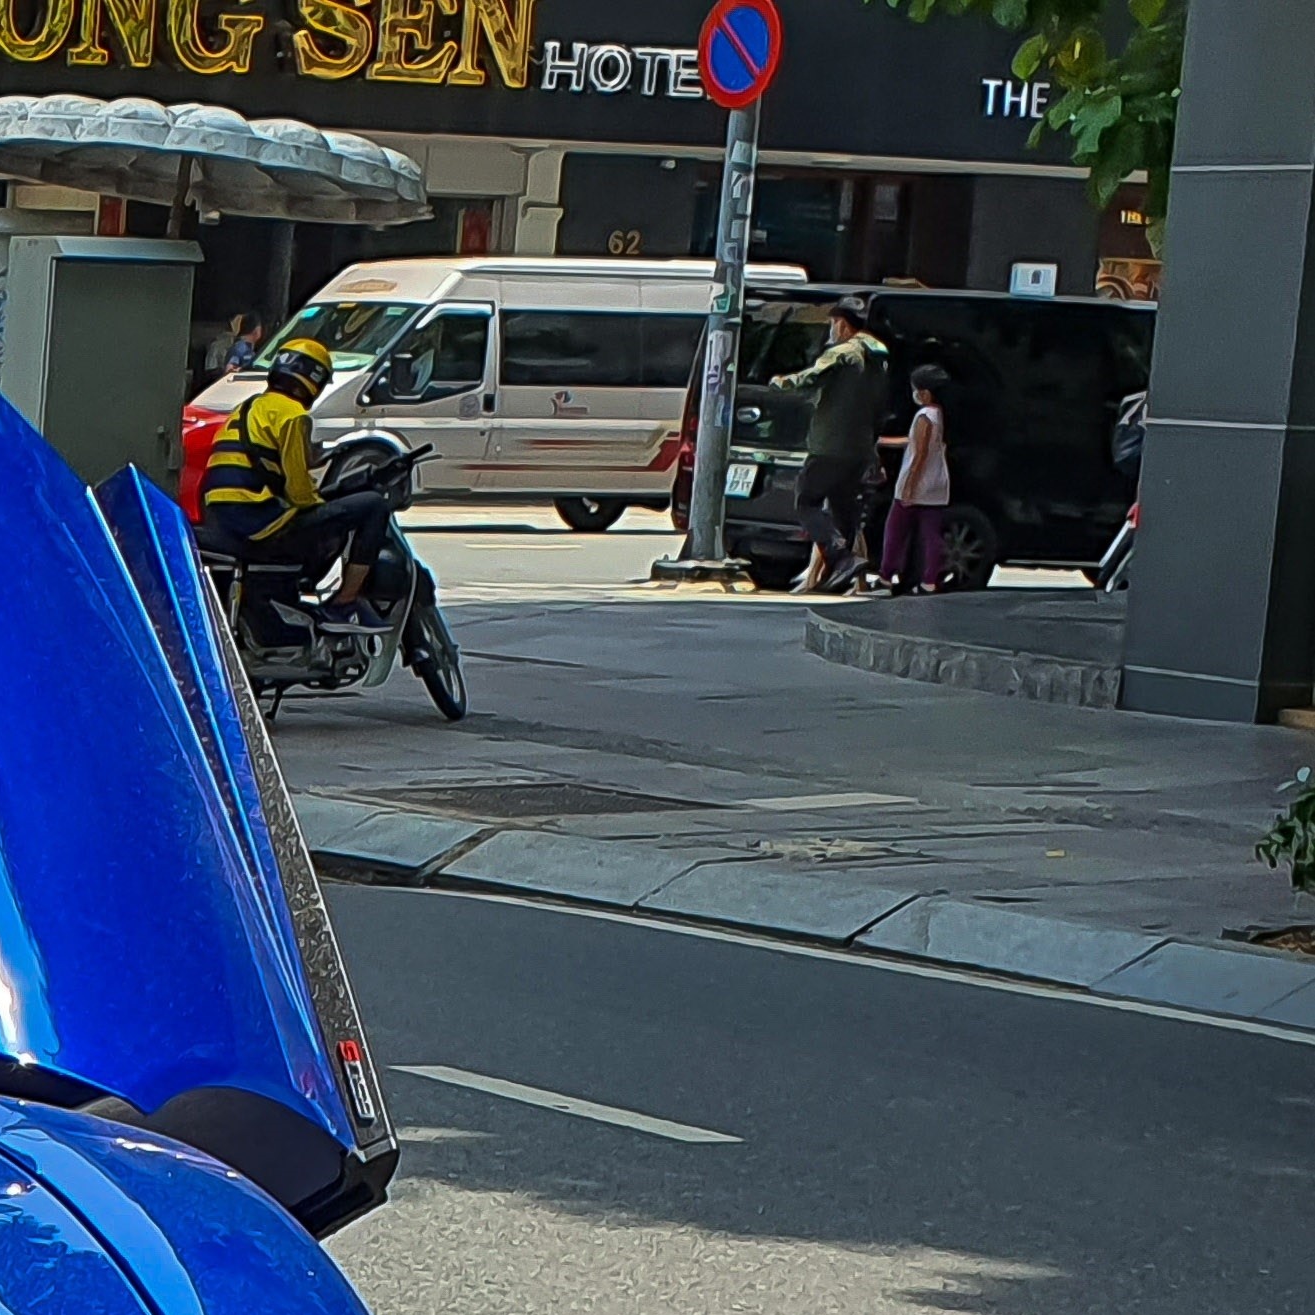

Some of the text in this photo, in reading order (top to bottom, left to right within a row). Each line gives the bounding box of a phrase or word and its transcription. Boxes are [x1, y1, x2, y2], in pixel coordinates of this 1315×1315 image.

[292, 0, 536, 88] SEN
[541, 41, 711, 100] HOTE
[981, 78, 1051, 119] THE
[608, 229, 641, 255] 62
